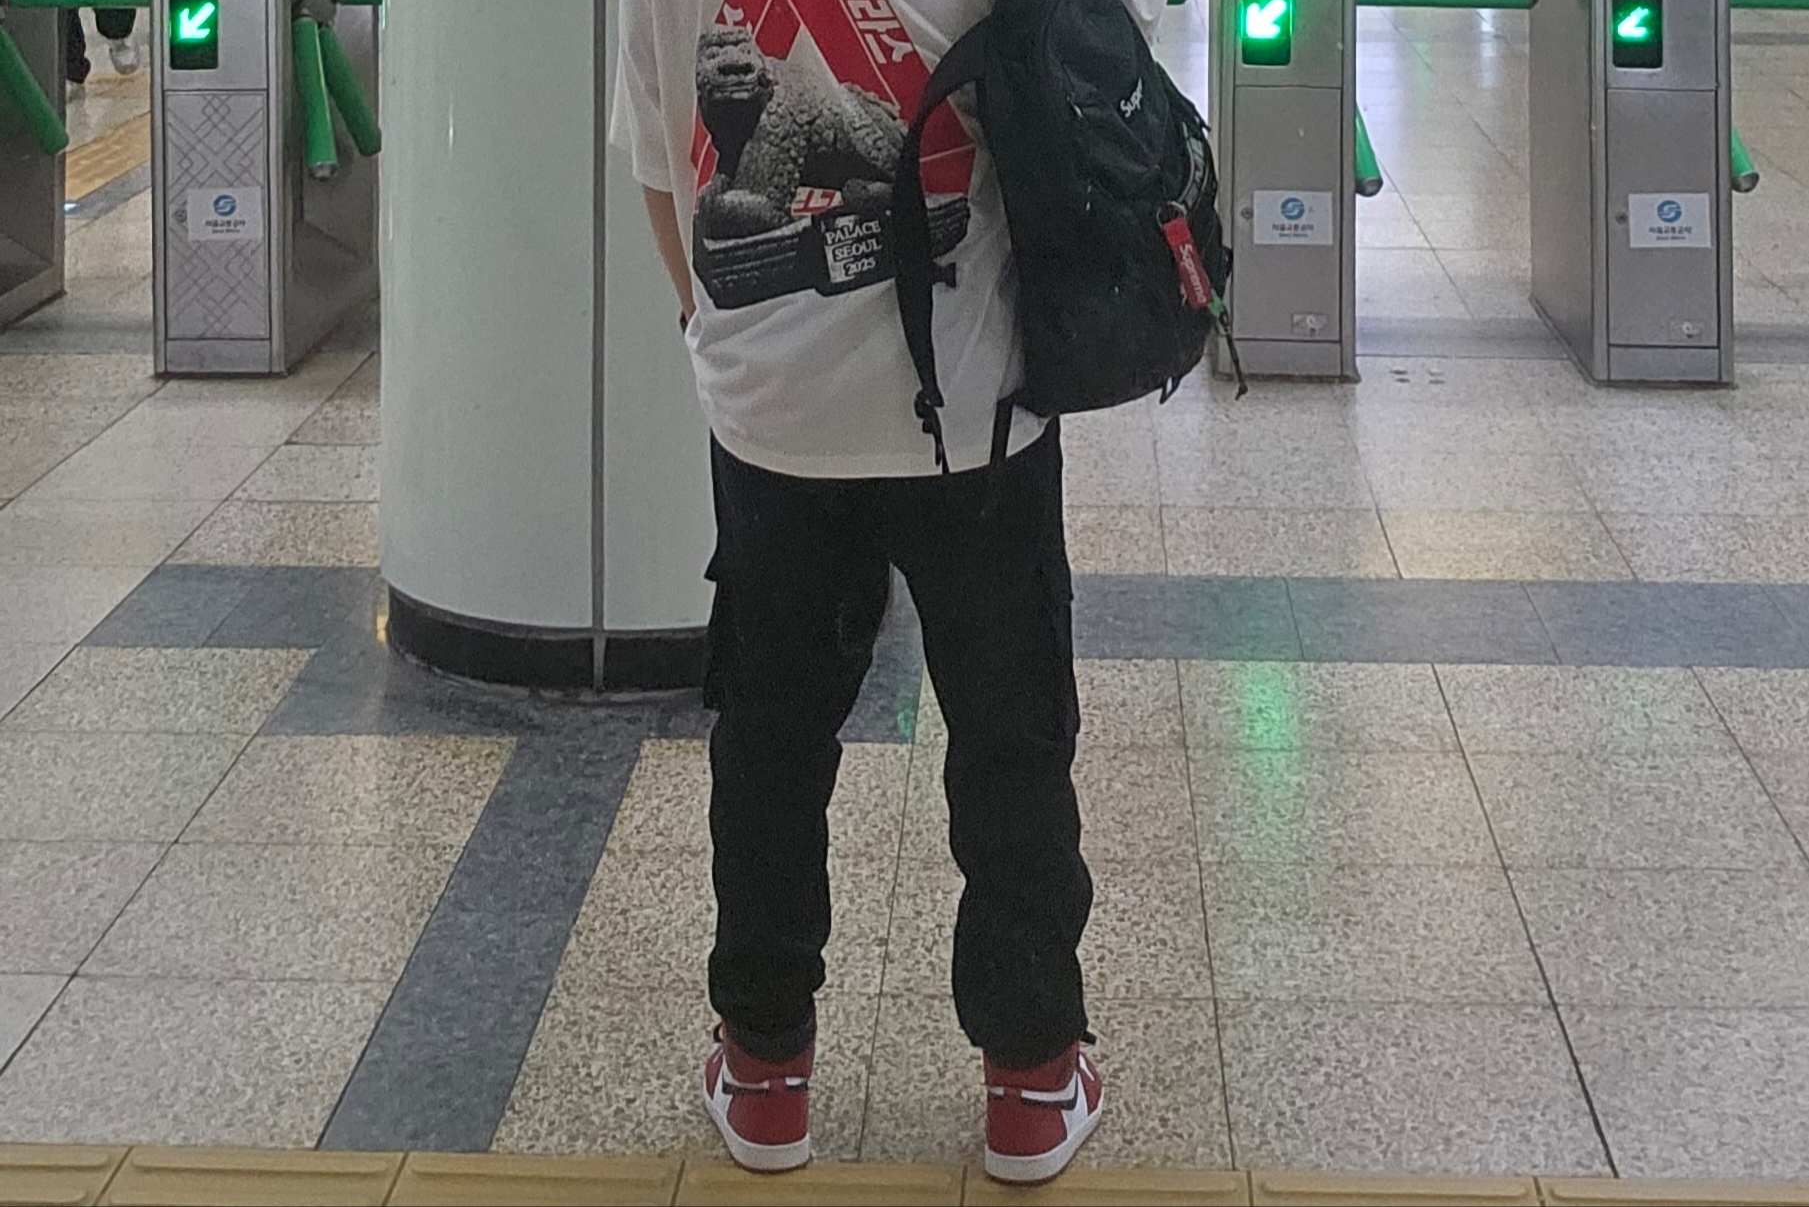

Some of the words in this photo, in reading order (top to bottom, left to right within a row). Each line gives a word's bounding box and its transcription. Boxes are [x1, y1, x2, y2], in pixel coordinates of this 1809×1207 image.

[825, 221, 882, 245] PALACE
[834, 238, 882, 261] SEOUL
[845, 257, 877, 275] 2025
